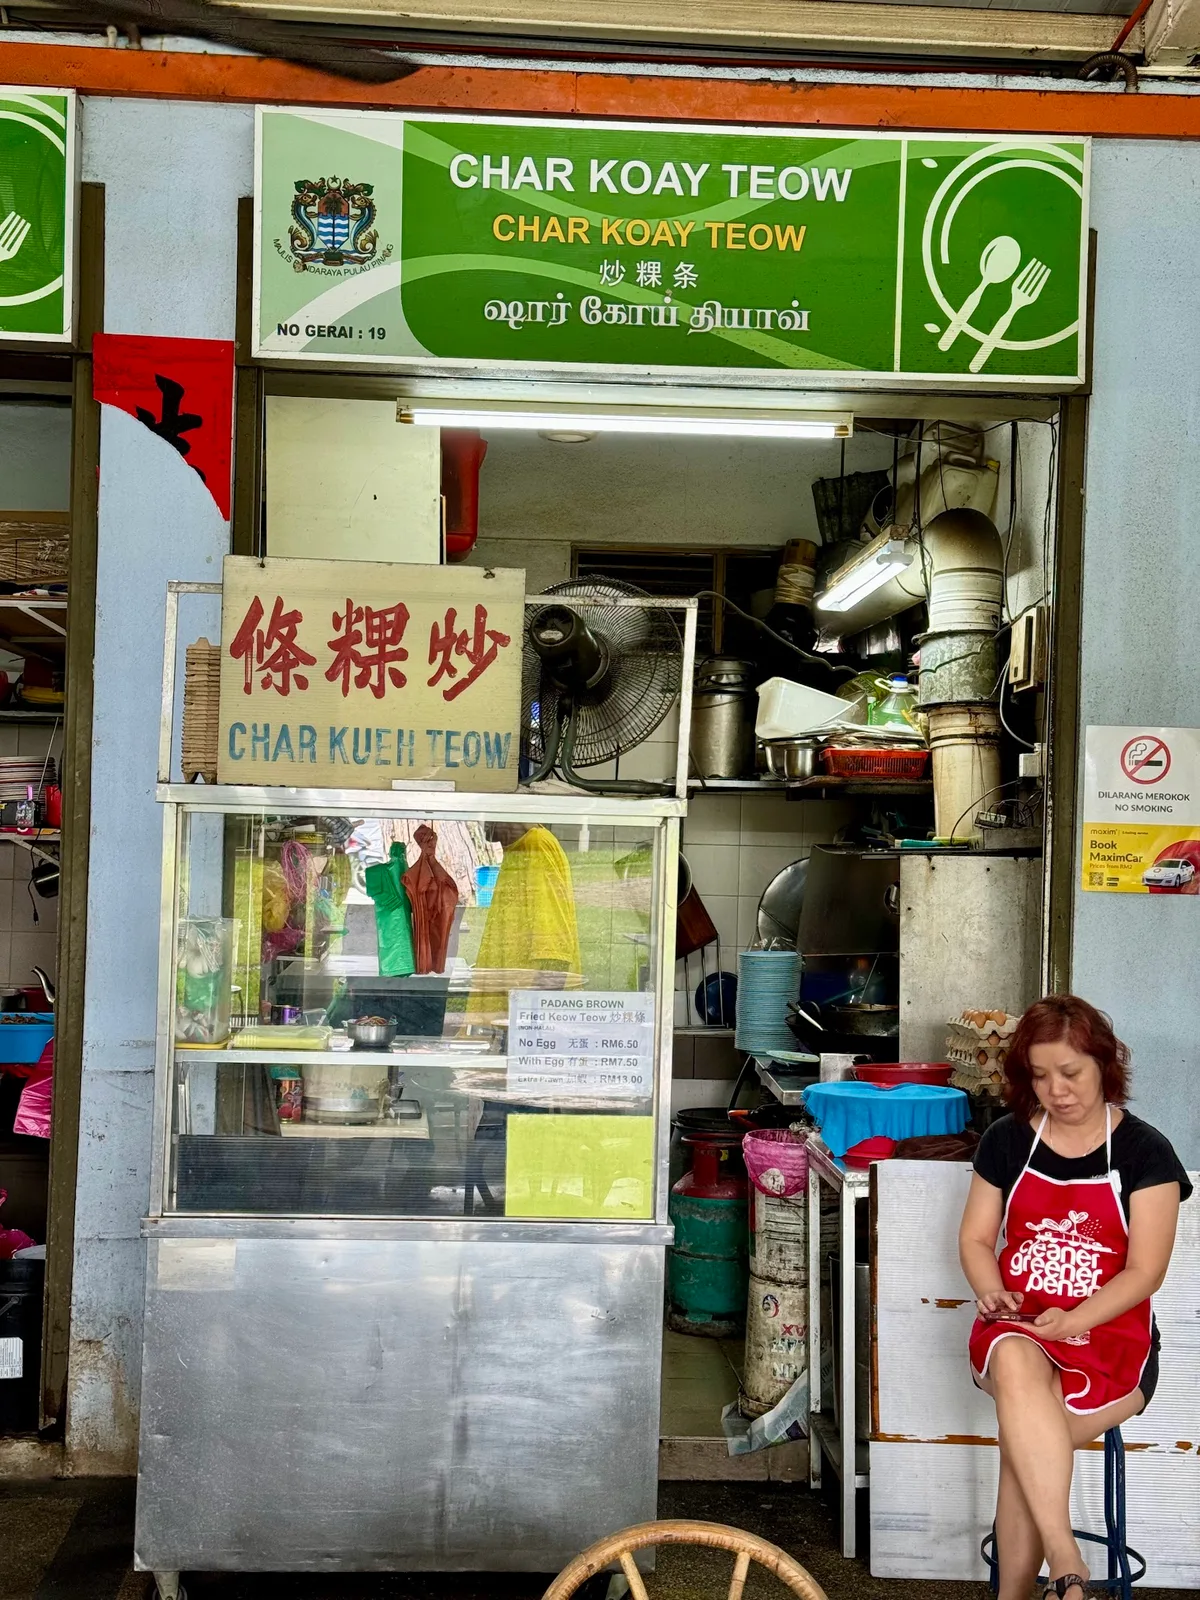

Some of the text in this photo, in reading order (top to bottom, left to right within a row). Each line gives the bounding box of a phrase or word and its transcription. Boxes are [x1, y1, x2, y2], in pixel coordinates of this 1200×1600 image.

[450, 153, 853, 203] CHAR KOAY TEOW
[492, 214, 806, 252] CHAR KOAY TEOW
[273, 238, 294, 263] MAJLIS
[292, 259, 343, 276] BNDARAYA
[343, 263, 371, 276] PULAU
[599, 259, 699, 289] 炒粿条
[483, 292, 811, 335] ஷார் கோய் தியாவ்
[277, 323, 300, 336] NO
[305, 324, 353, 338] GERAI
[368, 327, 386, 340] 19
[228, 722, 512, 769] CHAR KUEH TEOW
[1098, 791, 1190, 801] DILARANG MEROKOK
[1131, 804, 1173, 813] SMOKING
[1090, 840, 1117, 849] Book
[1090, 852, 1143, 862] MaximCar
[540, 999, 624, 1008] PADANG BROWN
[519, 1011, 546, 1021] Fried
[549, 1012, 577, 1021] Keow
[580, 1012, 607, 1021] Teow
[519, 1038, 533, 1047] No
[536, 1039, 556, 1049] Egg
[601, 1040, 638, 1048] RM6.50
[518, 1057, 541, 1065] With
[544, 1057, 564, 1067] Egg
[601, 1057, 638, 1066] RM7.50
[600, 1074, 642, 1084] RM13.00
[1009, 1252, 1103, 1287] greener
